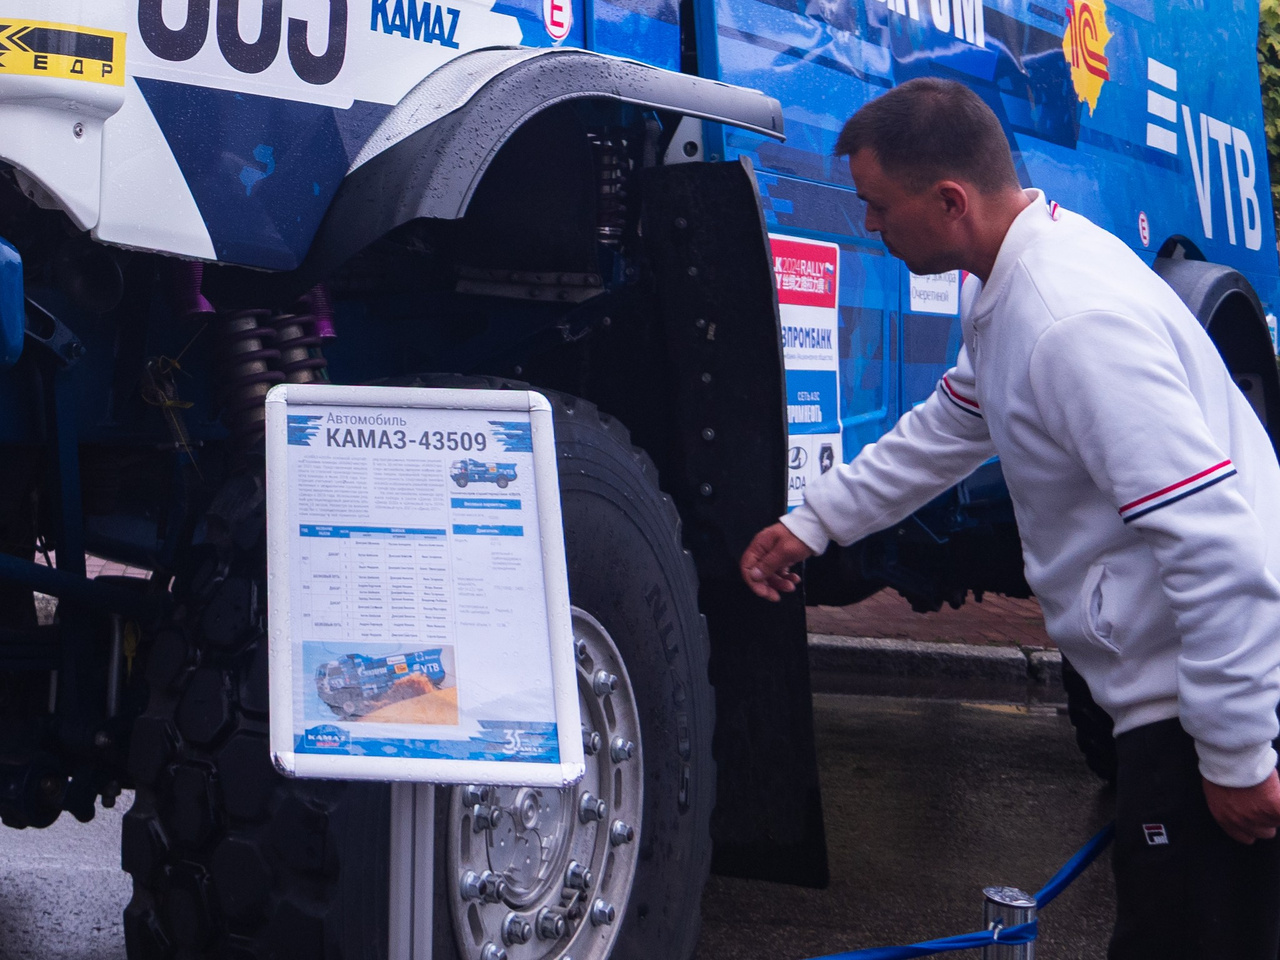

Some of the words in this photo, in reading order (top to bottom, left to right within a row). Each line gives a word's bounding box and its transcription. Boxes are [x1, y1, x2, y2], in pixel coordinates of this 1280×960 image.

[1181, 103, 1262, 253] VTB
[782, 325, 833, 350] ЗПРОМБАНК
[326, 411, 407, 427] Автомобиль
[325, 427, 487, 452] КАМАЗ-43509
[787, 476, 807, 491] ADA
